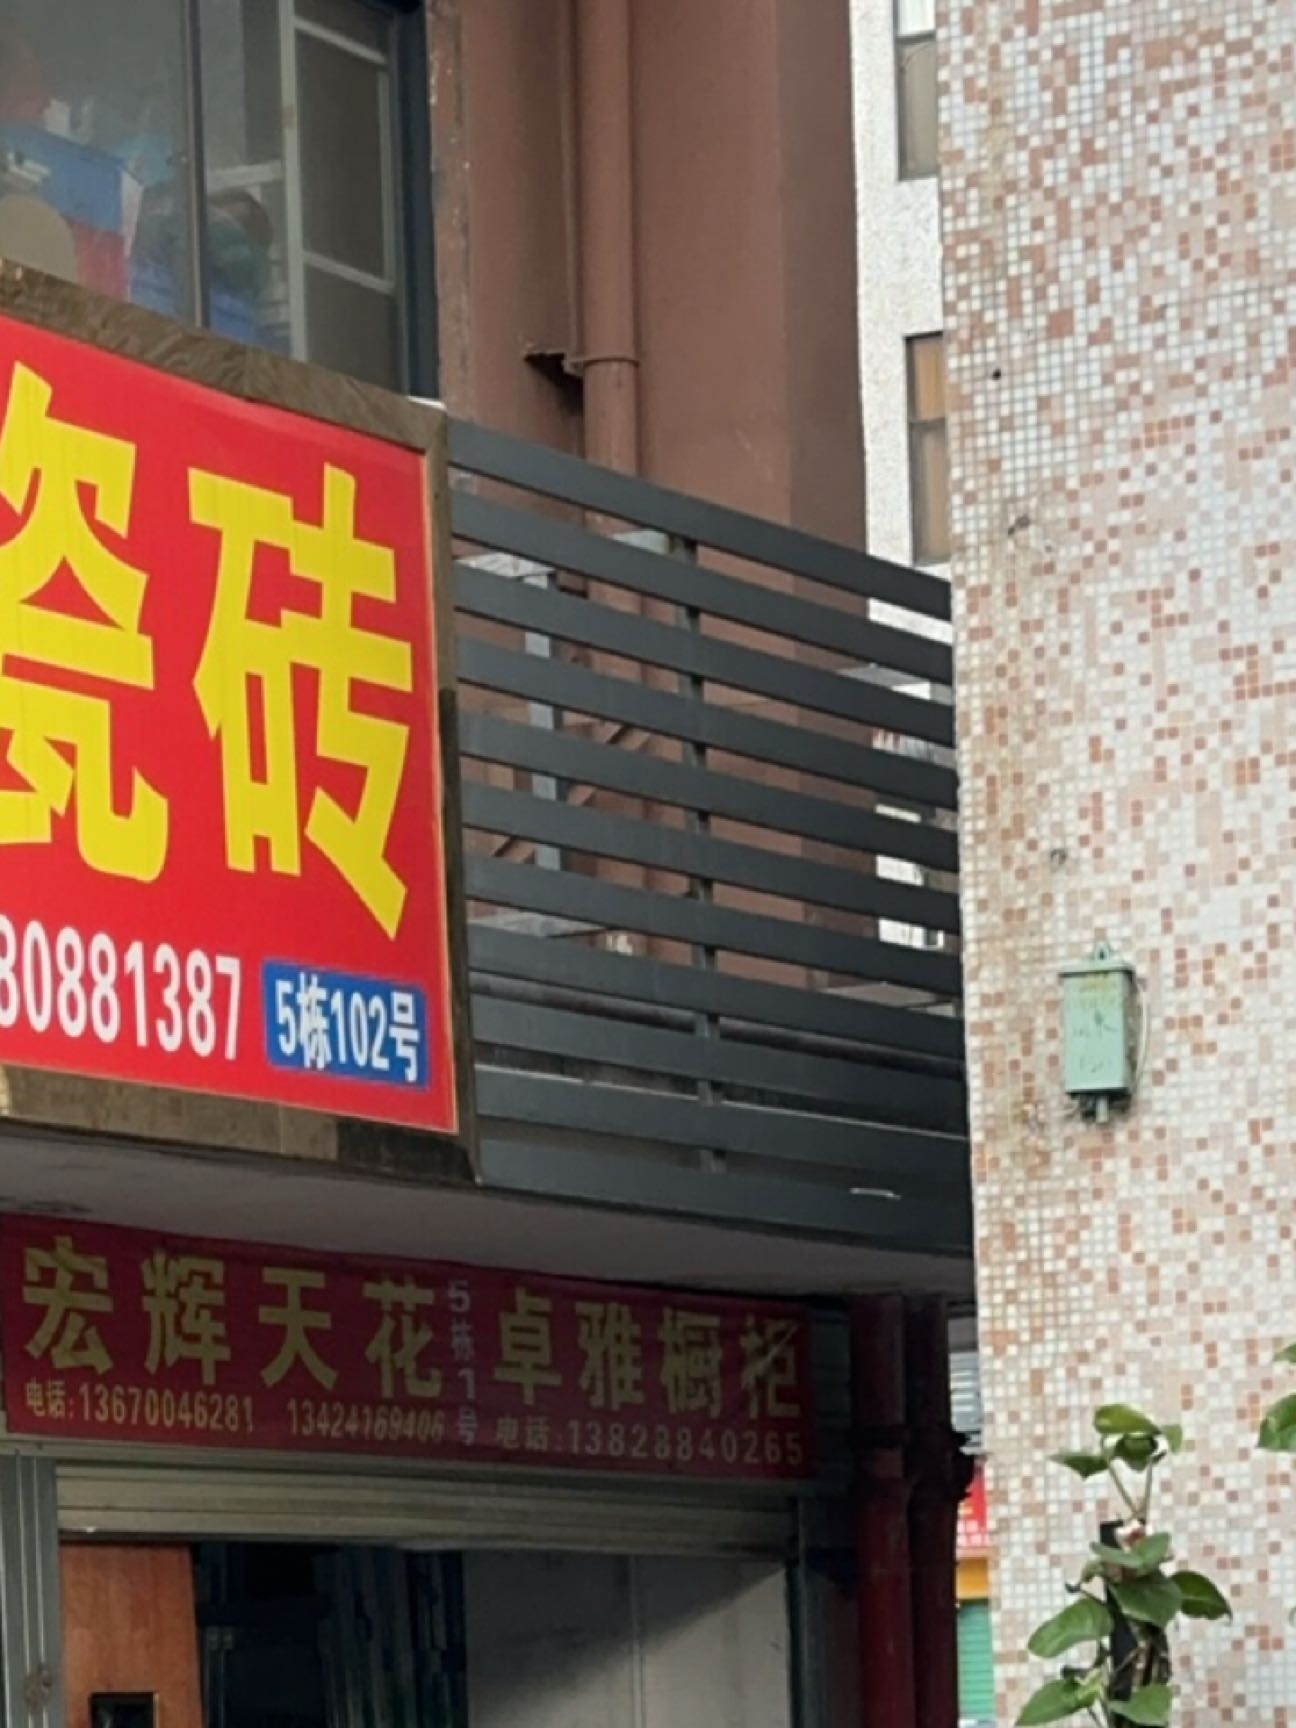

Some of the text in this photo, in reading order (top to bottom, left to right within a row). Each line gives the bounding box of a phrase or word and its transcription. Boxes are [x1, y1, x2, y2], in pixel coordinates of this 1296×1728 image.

[275, 972, 421, 1083] 5栋102号
[22, 1235, 441, 1400] 宏辉天花
